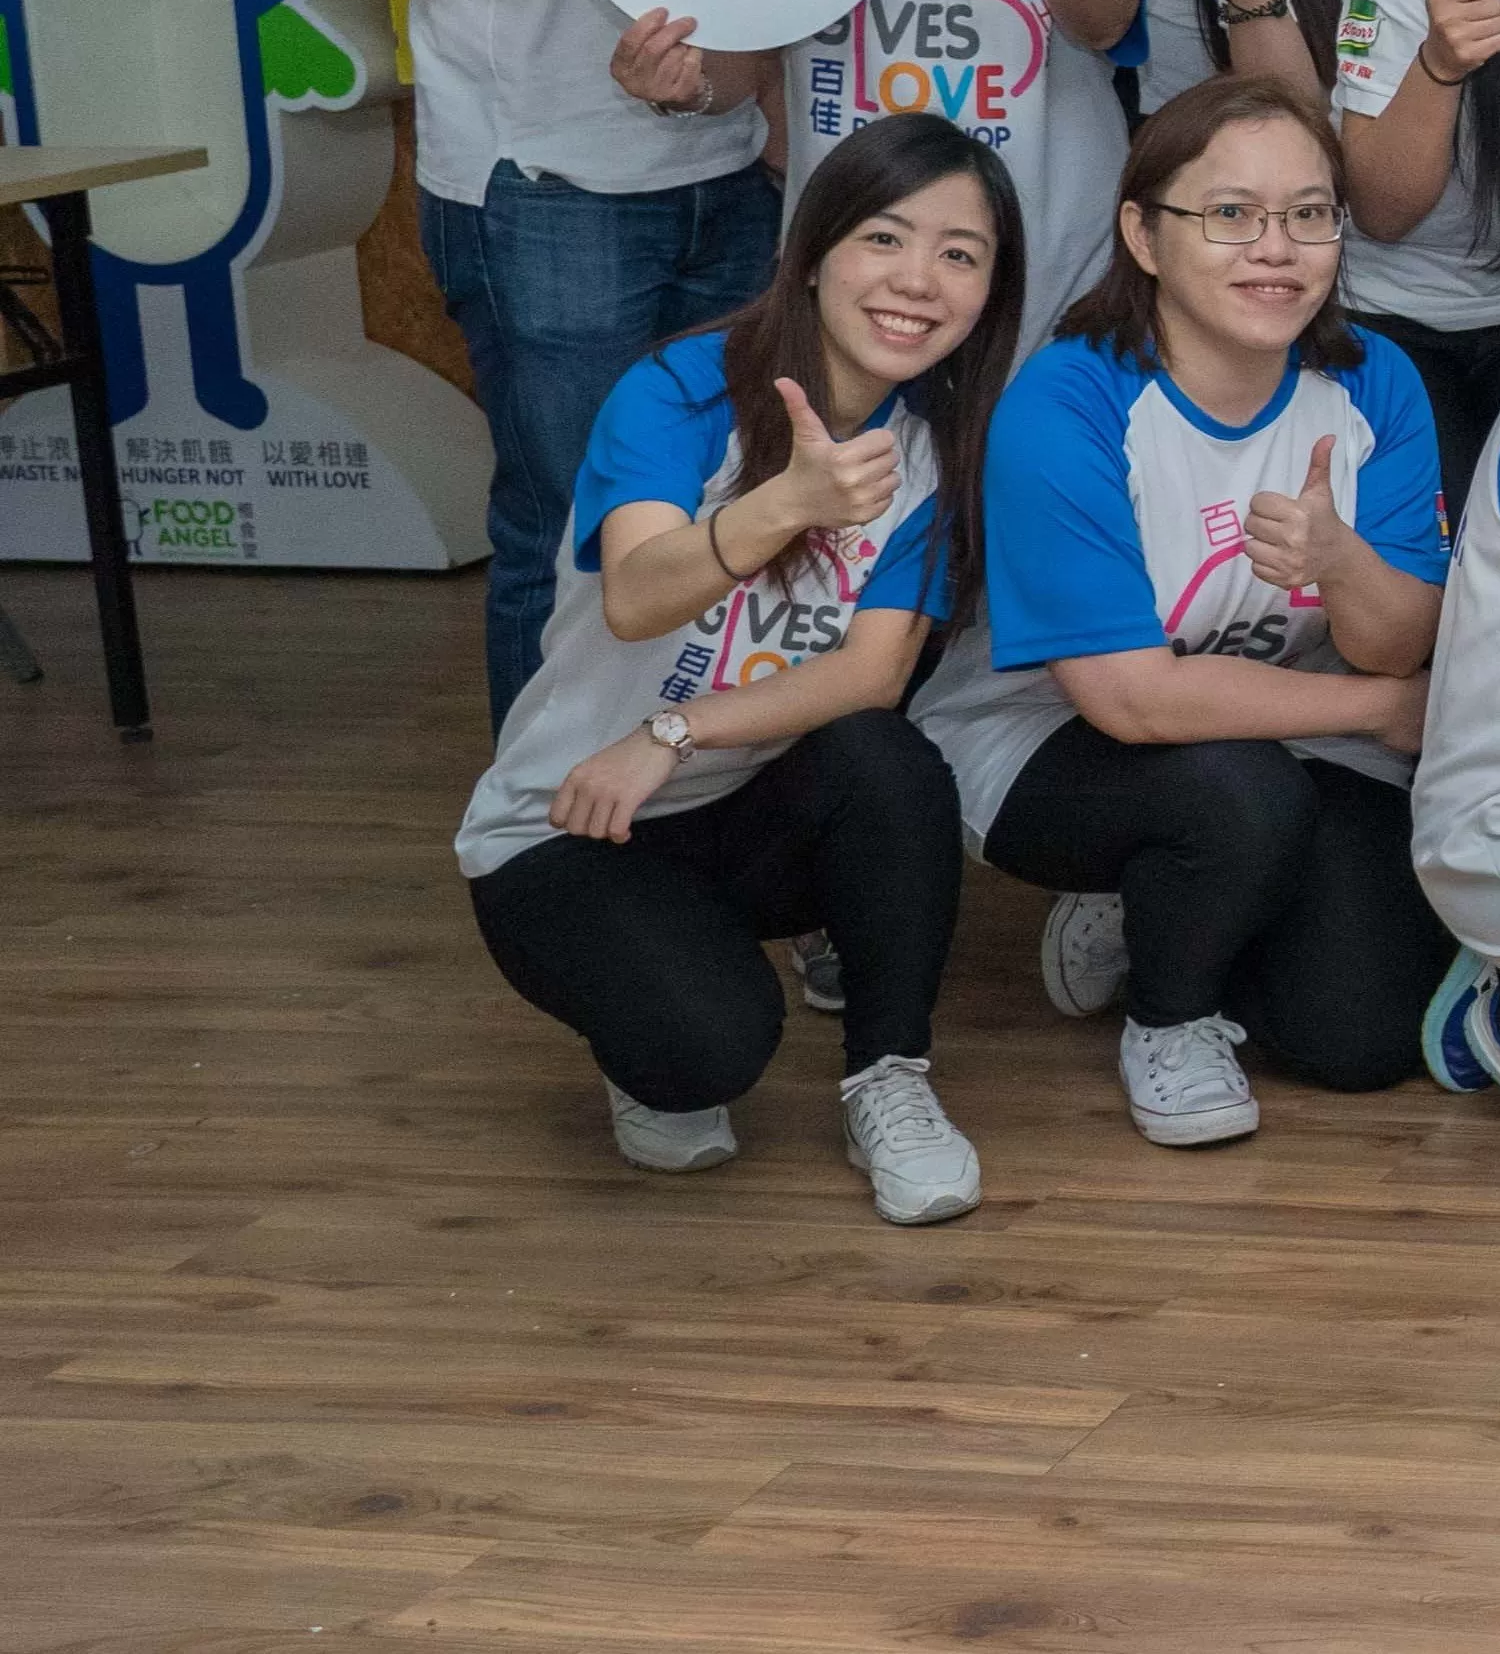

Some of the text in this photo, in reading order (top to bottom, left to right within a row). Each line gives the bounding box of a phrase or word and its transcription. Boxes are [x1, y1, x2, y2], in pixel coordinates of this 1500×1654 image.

[809, 57, 846, 137] 百佳
[121, 466, 200, 486] HUNGER
[205, 468, 245, 486] NOT
[267, 470, 319, 489] WITH
[323, 471, 372, 490] LOVE
[153, 499, 236, 526] FOOD
[157, 527, 238, 548] ANGEL
